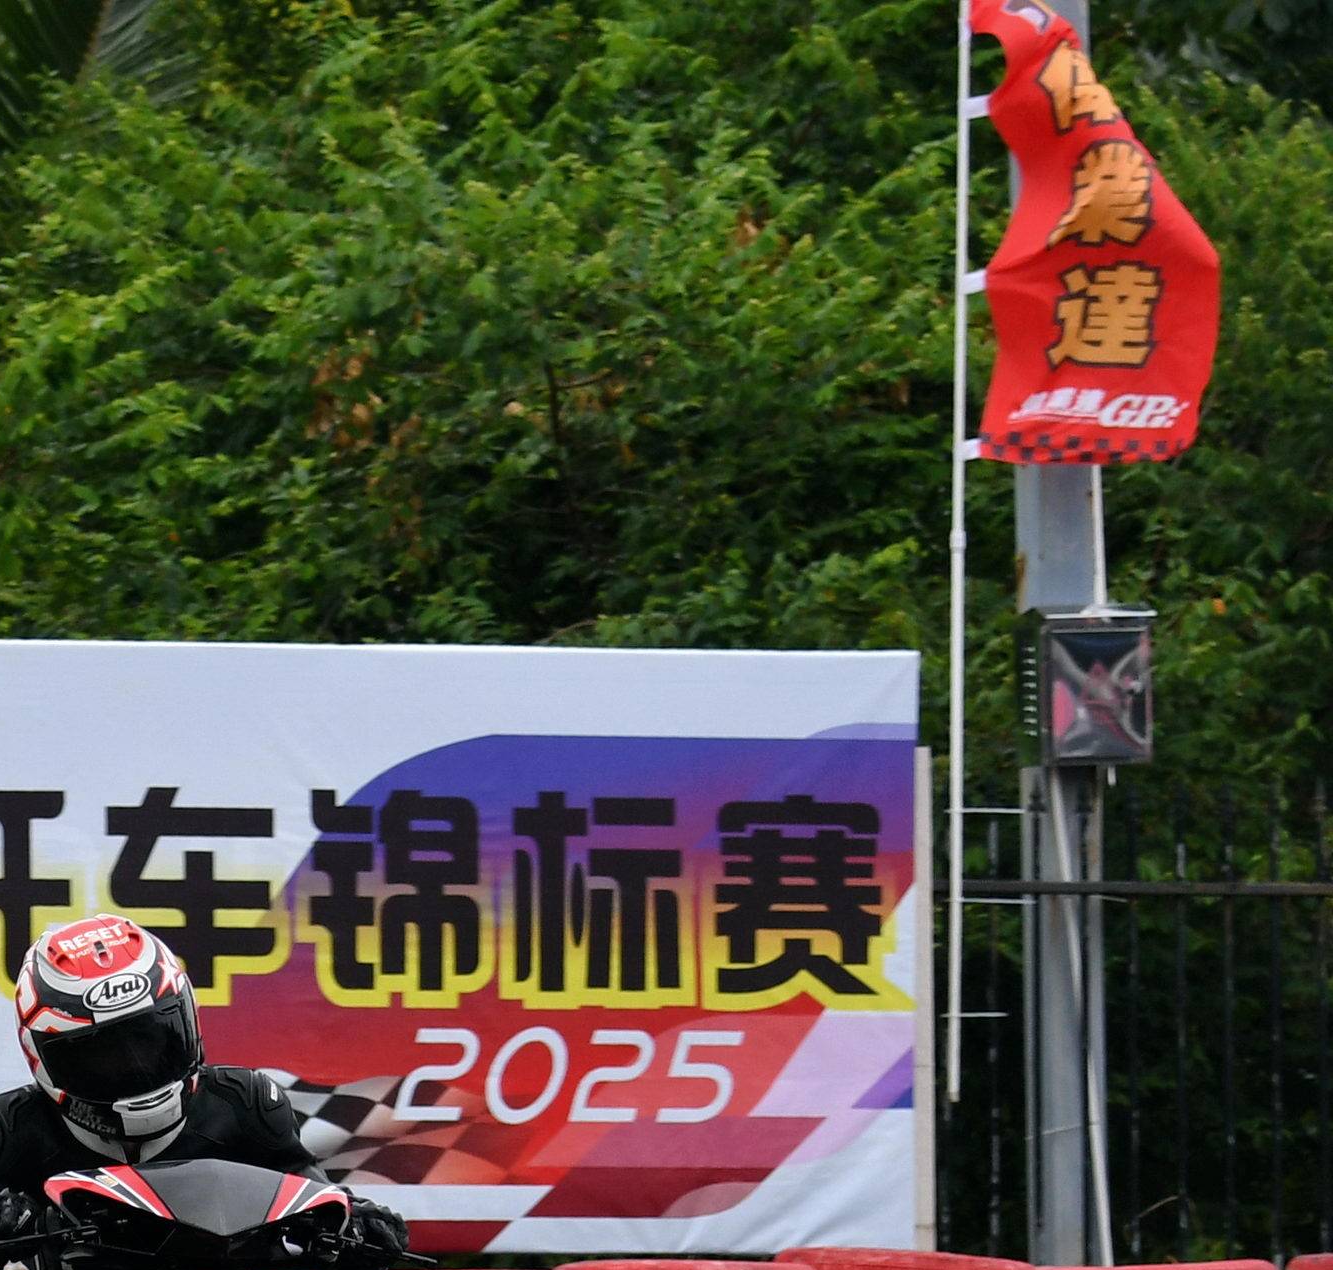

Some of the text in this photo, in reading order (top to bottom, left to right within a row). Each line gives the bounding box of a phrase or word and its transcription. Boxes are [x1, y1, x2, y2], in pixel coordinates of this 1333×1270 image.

[57, 923, 124, 951] RESET
[91, 974, 141, 1006] Arai
[393, 1026, 745, 1125] 2025
